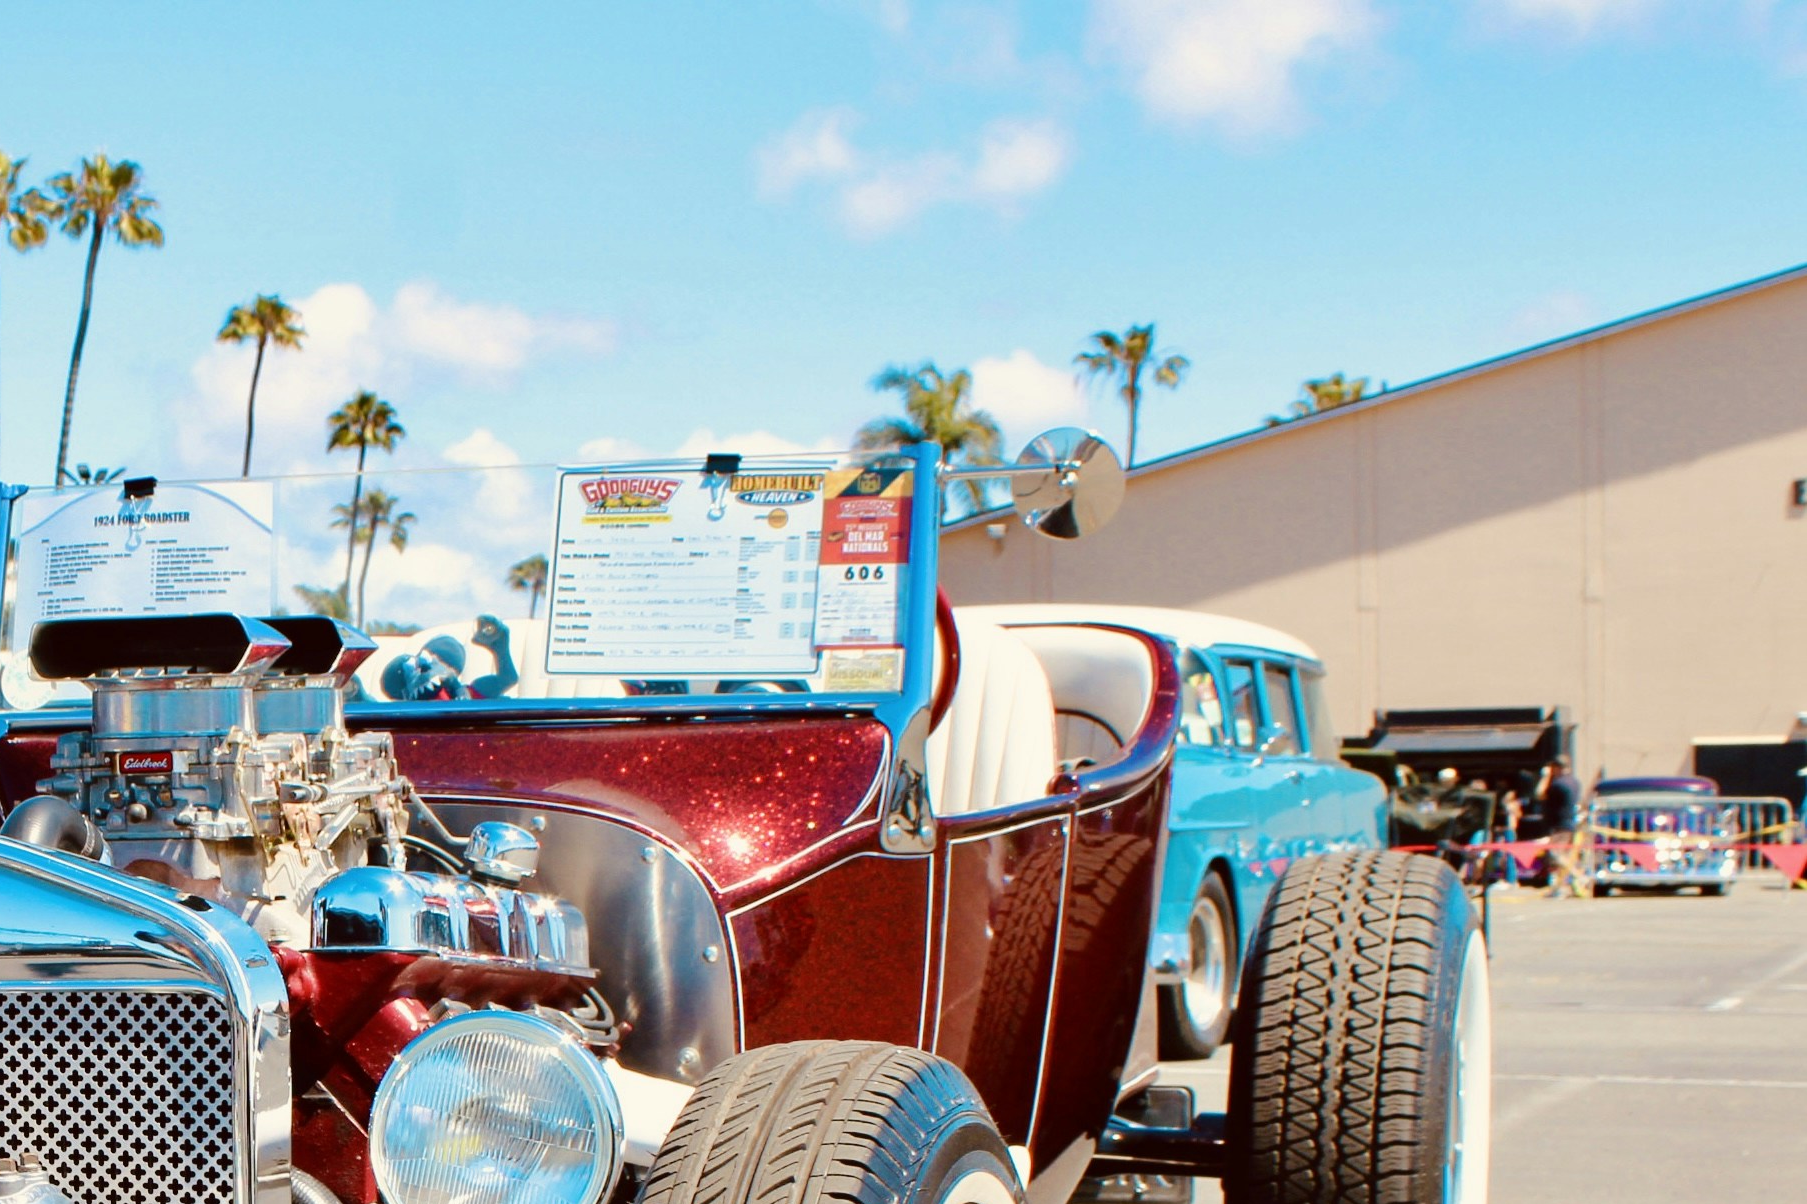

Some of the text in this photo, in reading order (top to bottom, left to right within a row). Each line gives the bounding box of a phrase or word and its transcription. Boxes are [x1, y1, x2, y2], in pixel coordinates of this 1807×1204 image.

[731, 474, 824, 492] HOMEBUILT
[580, 478, 679, 503] GOODGUYS
[750, 491, 798, 503] HEAVEN
[94, 514, 115, 528] 1924
[143, 511, 191, 525] ROADSTER
[848, 531, 885, 542] DEL MAR
[842, 541, 889, 554] NATIONALS
[844, 565, 885, 580] 606
[124, 757, 168, 770] Edelbrock
